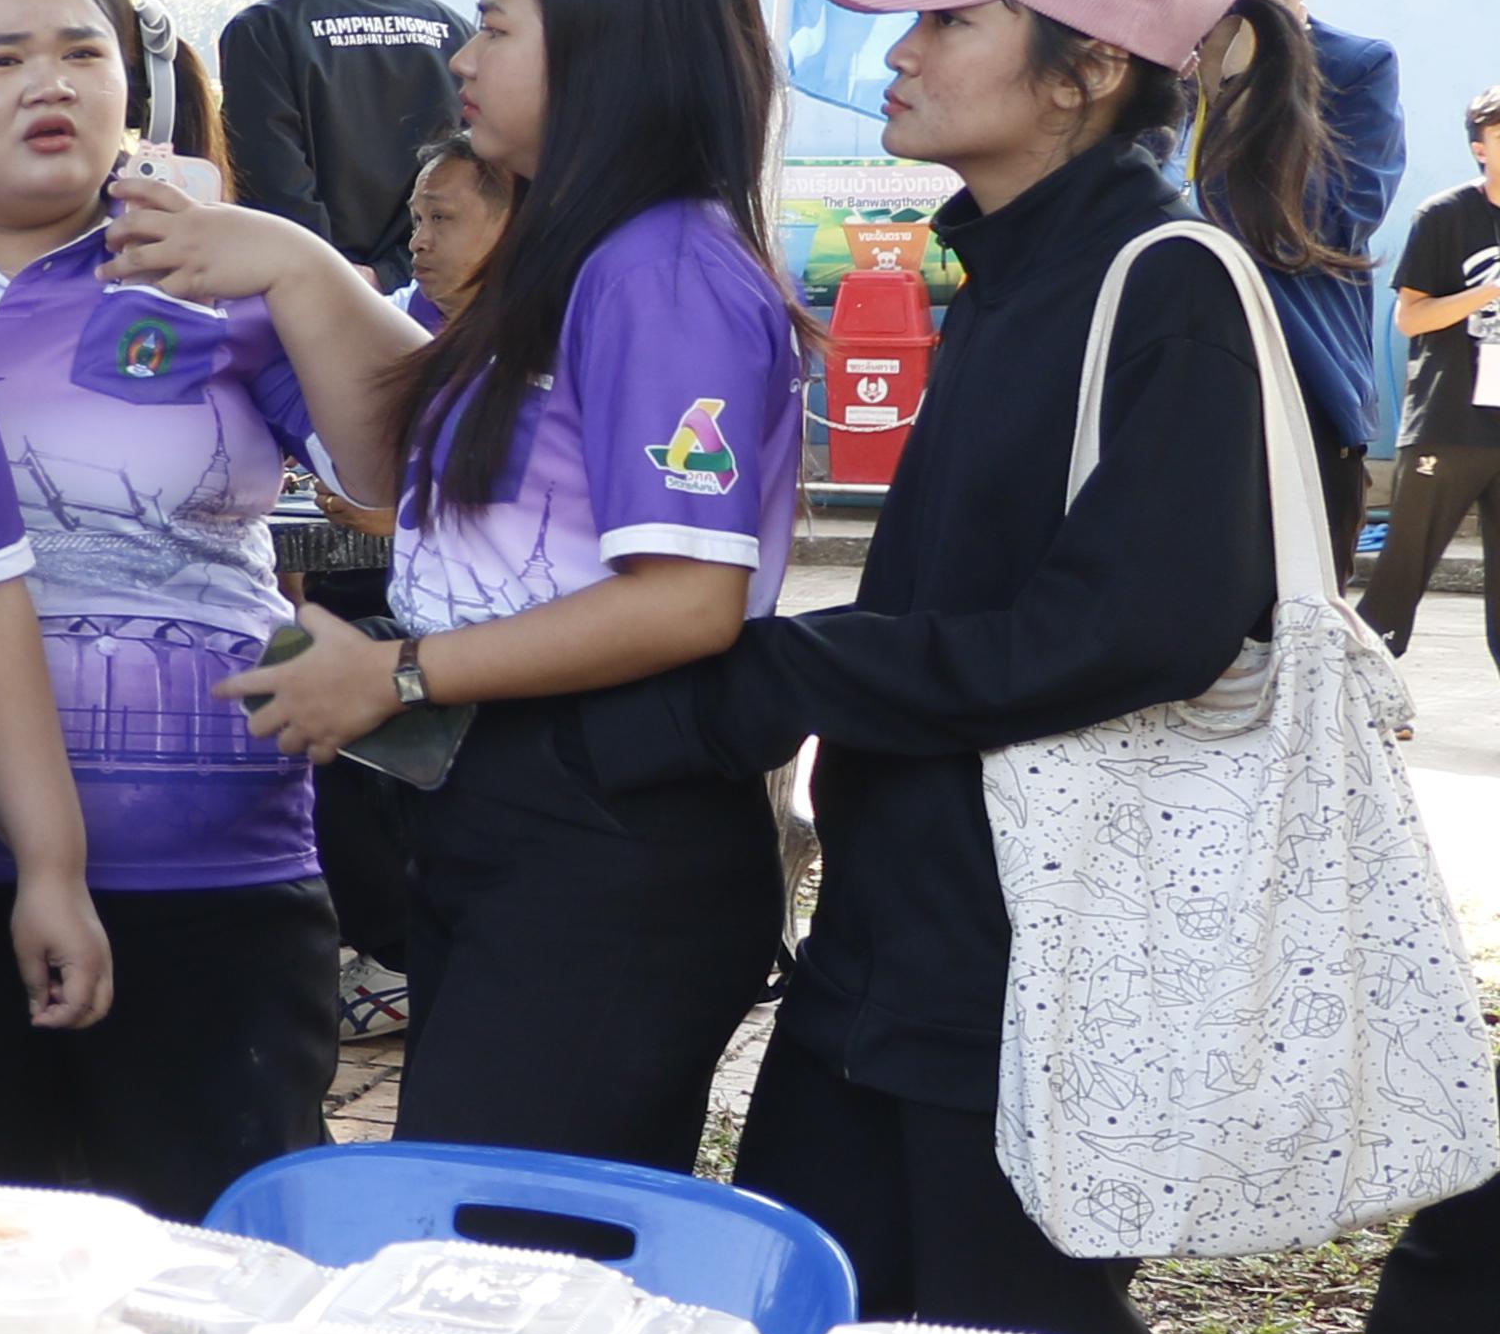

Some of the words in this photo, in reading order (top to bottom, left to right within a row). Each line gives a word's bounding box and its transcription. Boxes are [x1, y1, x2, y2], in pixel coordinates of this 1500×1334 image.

[311, 16, 449, 38] KAMPHAENGPHET
[330, 34, 382, 46] RAJABHAT
[385, 34, 442, 49] UNIVERSITY
[823, 196, 843, 207] The
[848, 196, 937, 210] Banwangthong
